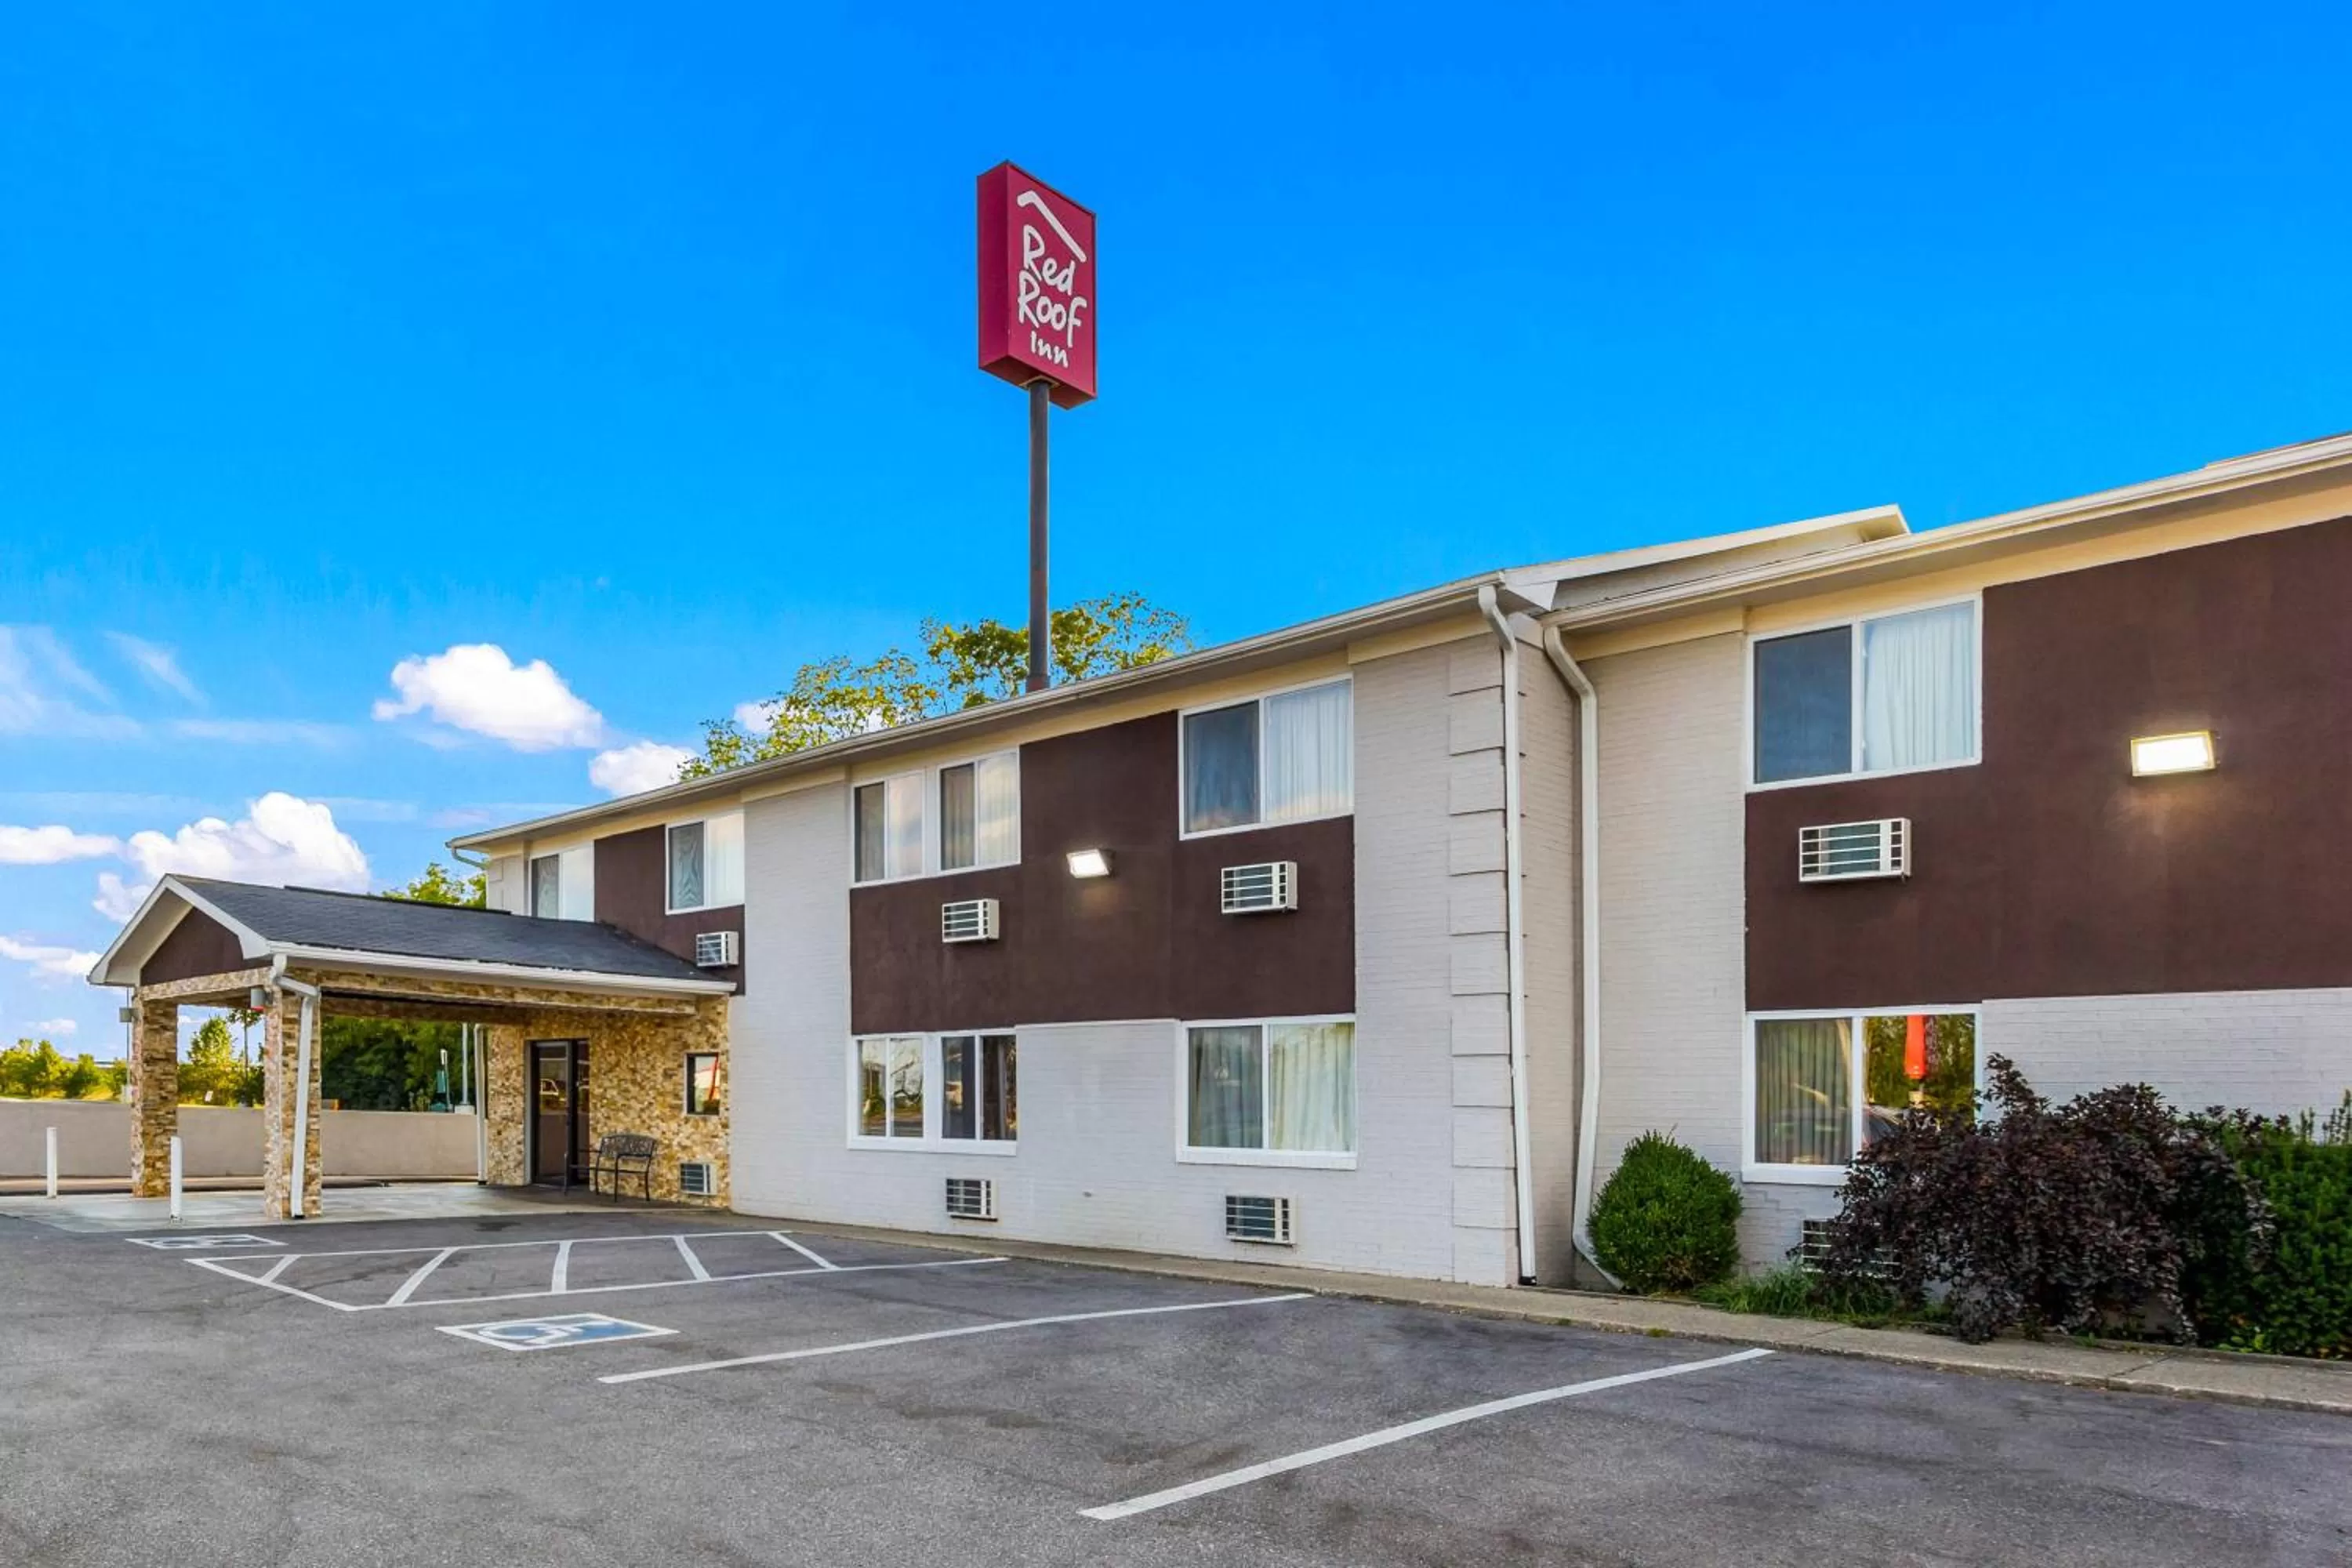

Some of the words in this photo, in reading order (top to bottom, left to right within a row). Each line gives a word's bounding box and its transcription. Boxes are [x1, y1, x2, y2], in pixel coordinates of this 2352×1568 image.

[1022, 224, 1076, 296] Red
[1018, 270, 1087, 347] Roof
[1030, 330, 1069, 368] Inn
